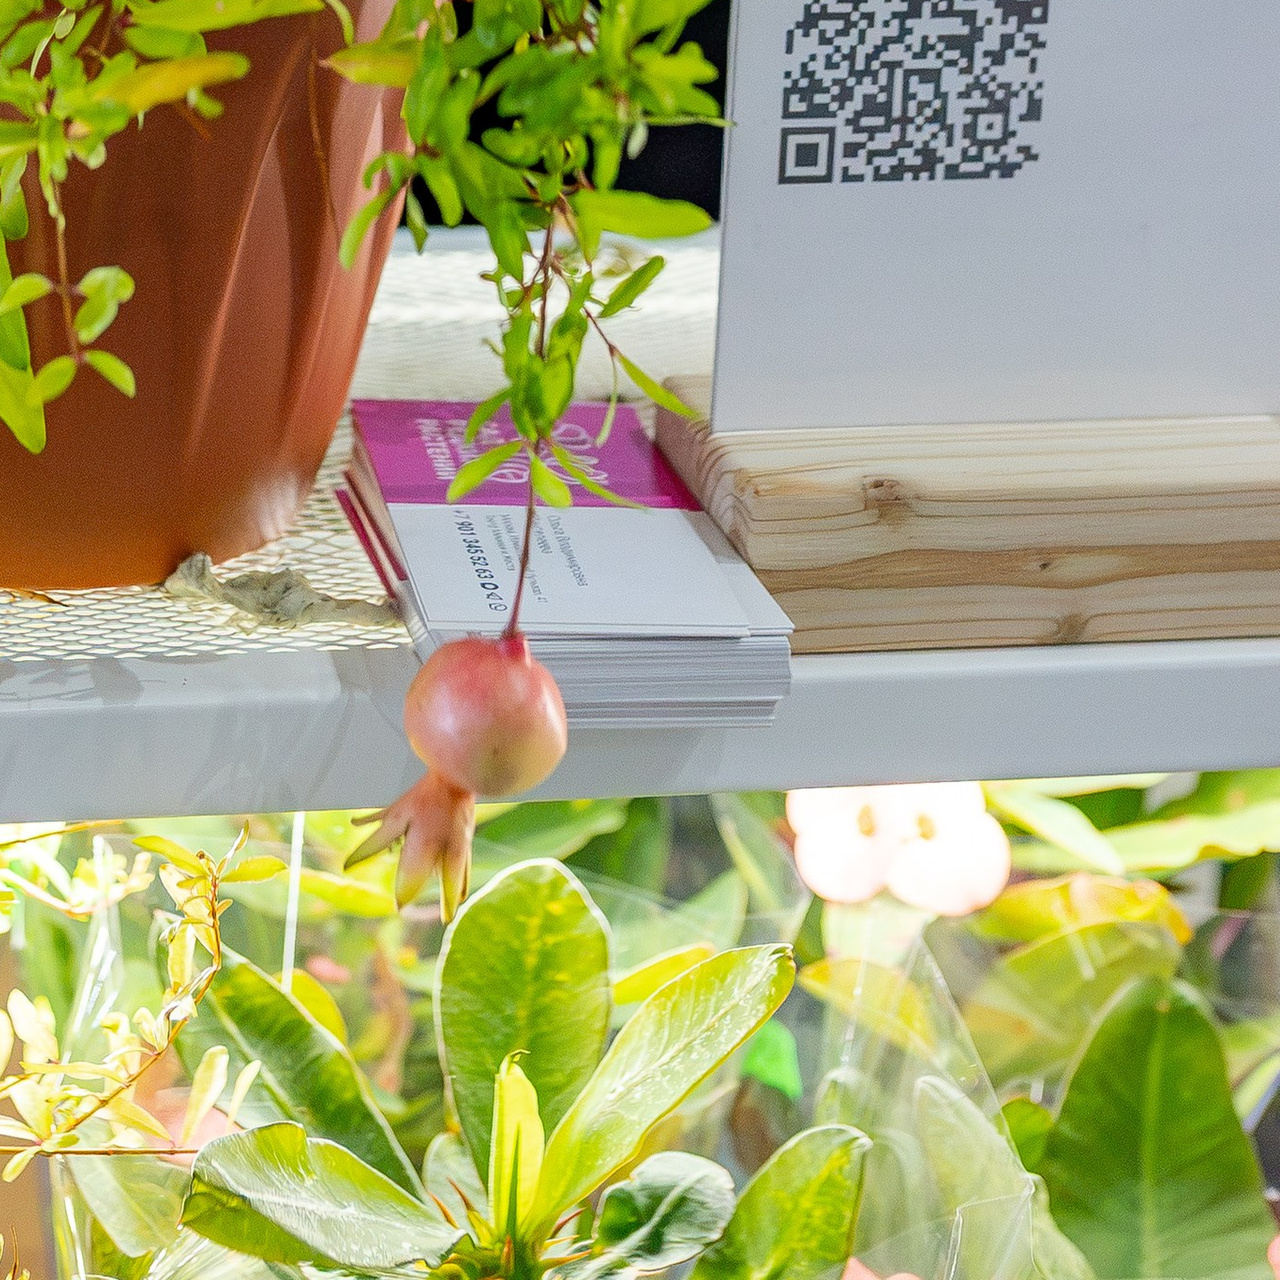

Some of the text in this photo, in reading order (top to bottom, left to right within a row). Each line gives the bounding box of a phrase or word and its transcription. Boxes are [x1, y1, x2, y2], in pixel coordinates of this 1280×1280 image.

[454, 520, 477, 536] 901
[462, 538, 484, 555] 345
[469, 555, 489, 567] 52
[474, 567, 494, 579] 63
